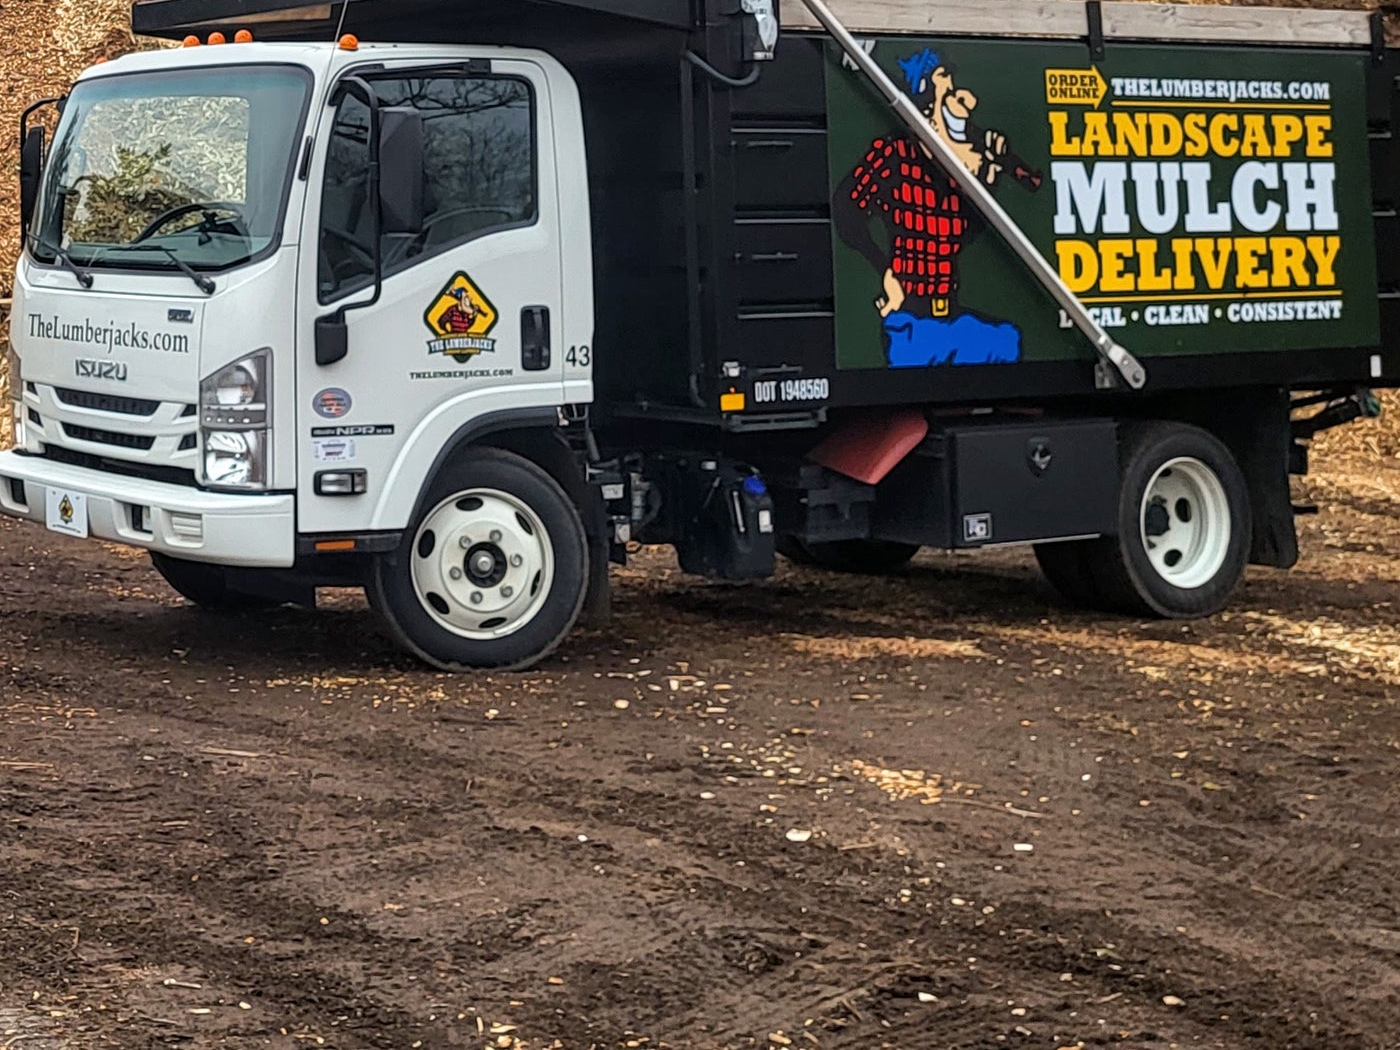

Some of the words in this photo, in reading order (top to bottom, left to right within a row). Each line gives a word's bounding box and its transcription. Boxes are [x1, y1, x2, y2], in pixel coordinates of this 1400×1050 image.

[1049, 74, 1098, 87] ORDER
[1049, 87, 1100, 99] ONLINE
[1111, 77, 1330, 102] THELUMBERJACKS.COM
[1048, 111, 1333, 157] LANDSCAPE
[1050, 161, 1339, 234] MULCH
[1055, 236, 1340, 293] DELIVERY
[1059, 306, 1127, 328] LCAL
[1144, 304, 1209, 326] CLEAN
[1227, 300, 1342, 322] CONSISTENT
[28, 313, 189, 354] TheLumberjacks.com
[565, 345, 590, 367] 43
[75, 359, 128, 381] ISUZU
[754, 381, 777, 402] DOT
[780, 378, 829, 401] 1948560
